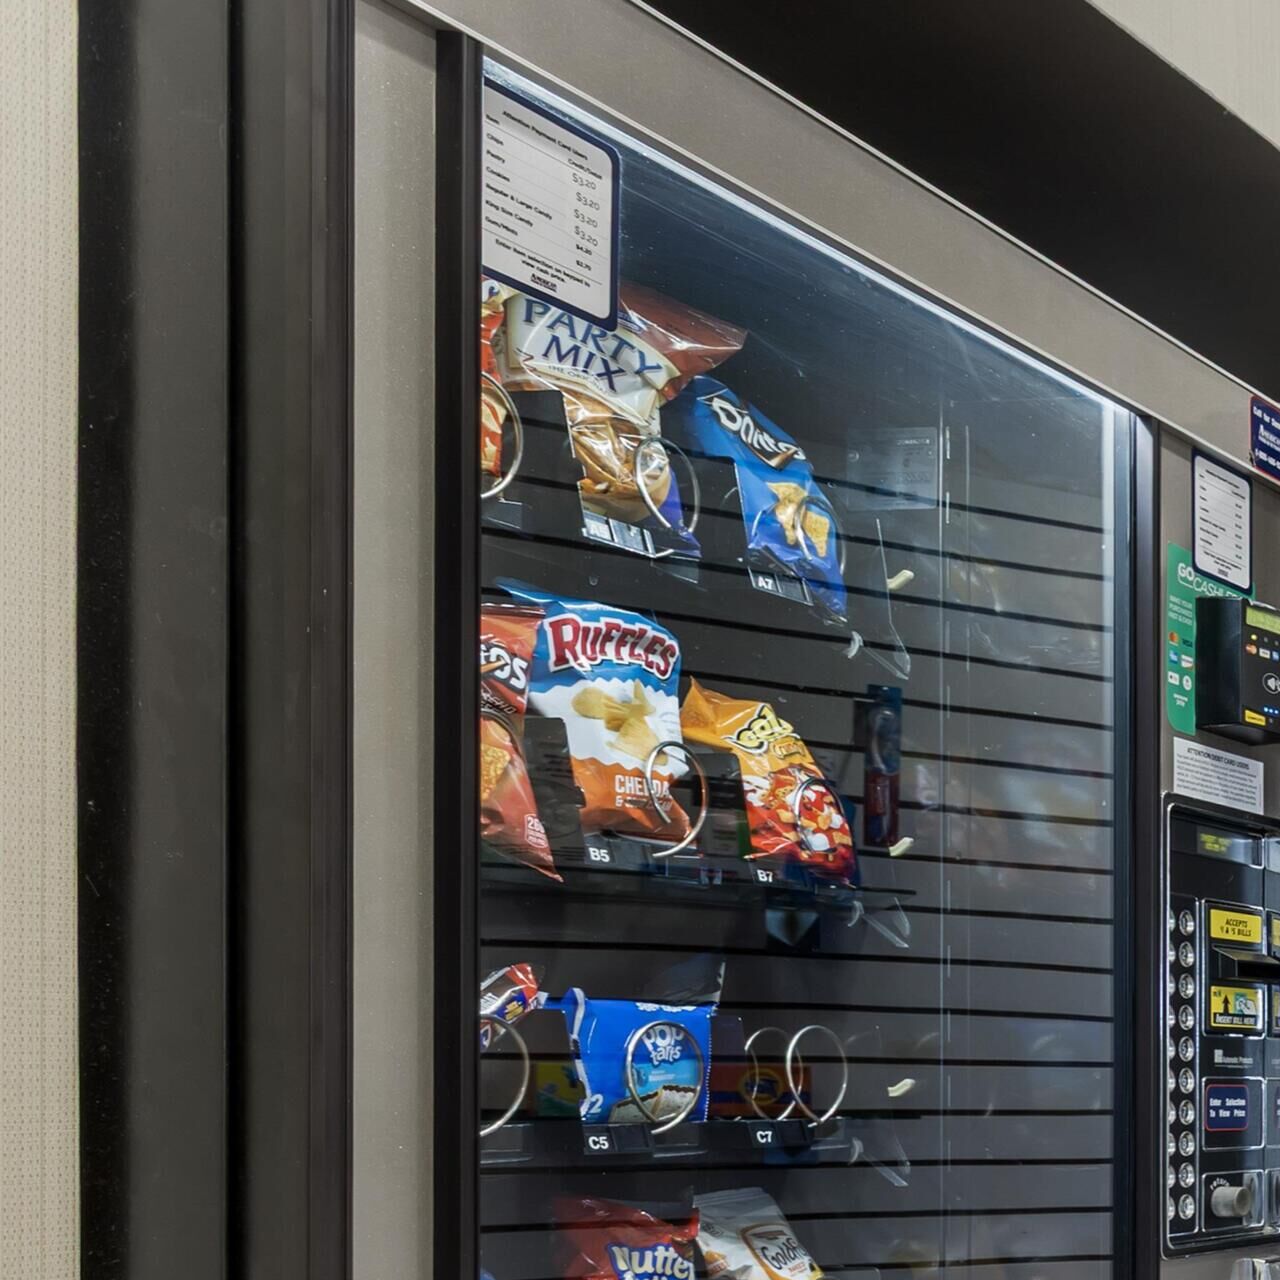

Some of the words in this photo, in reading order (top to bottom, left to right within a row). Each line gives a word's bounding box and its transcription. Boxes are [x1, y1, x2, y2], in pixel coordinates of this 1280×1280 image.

[531, 126, 557, 144] Payment
[523, 297, 663, 377] PARTY
[541, 334, 627, 393] MIX
[1177, 561, 1196, 581] GO
[757, 576, 774, 591] A7
[547, 614, 681, 680] RUFFLES
[588, 847, 611, 863] B5
[756, 869, 775, 883] B7
[1225, 917, 1249, 929] ACCEPTS
[1209, 1097, 1222, 1106] Enter
[1225, 1097, 1246, 1106] Selection
[1218, 1109, 1231, 1118] View
[1233, 1109, 1246, 1118] Price
[588, 1135, 610, 1150] C5
[756, 1130, 773, 1144] C7
